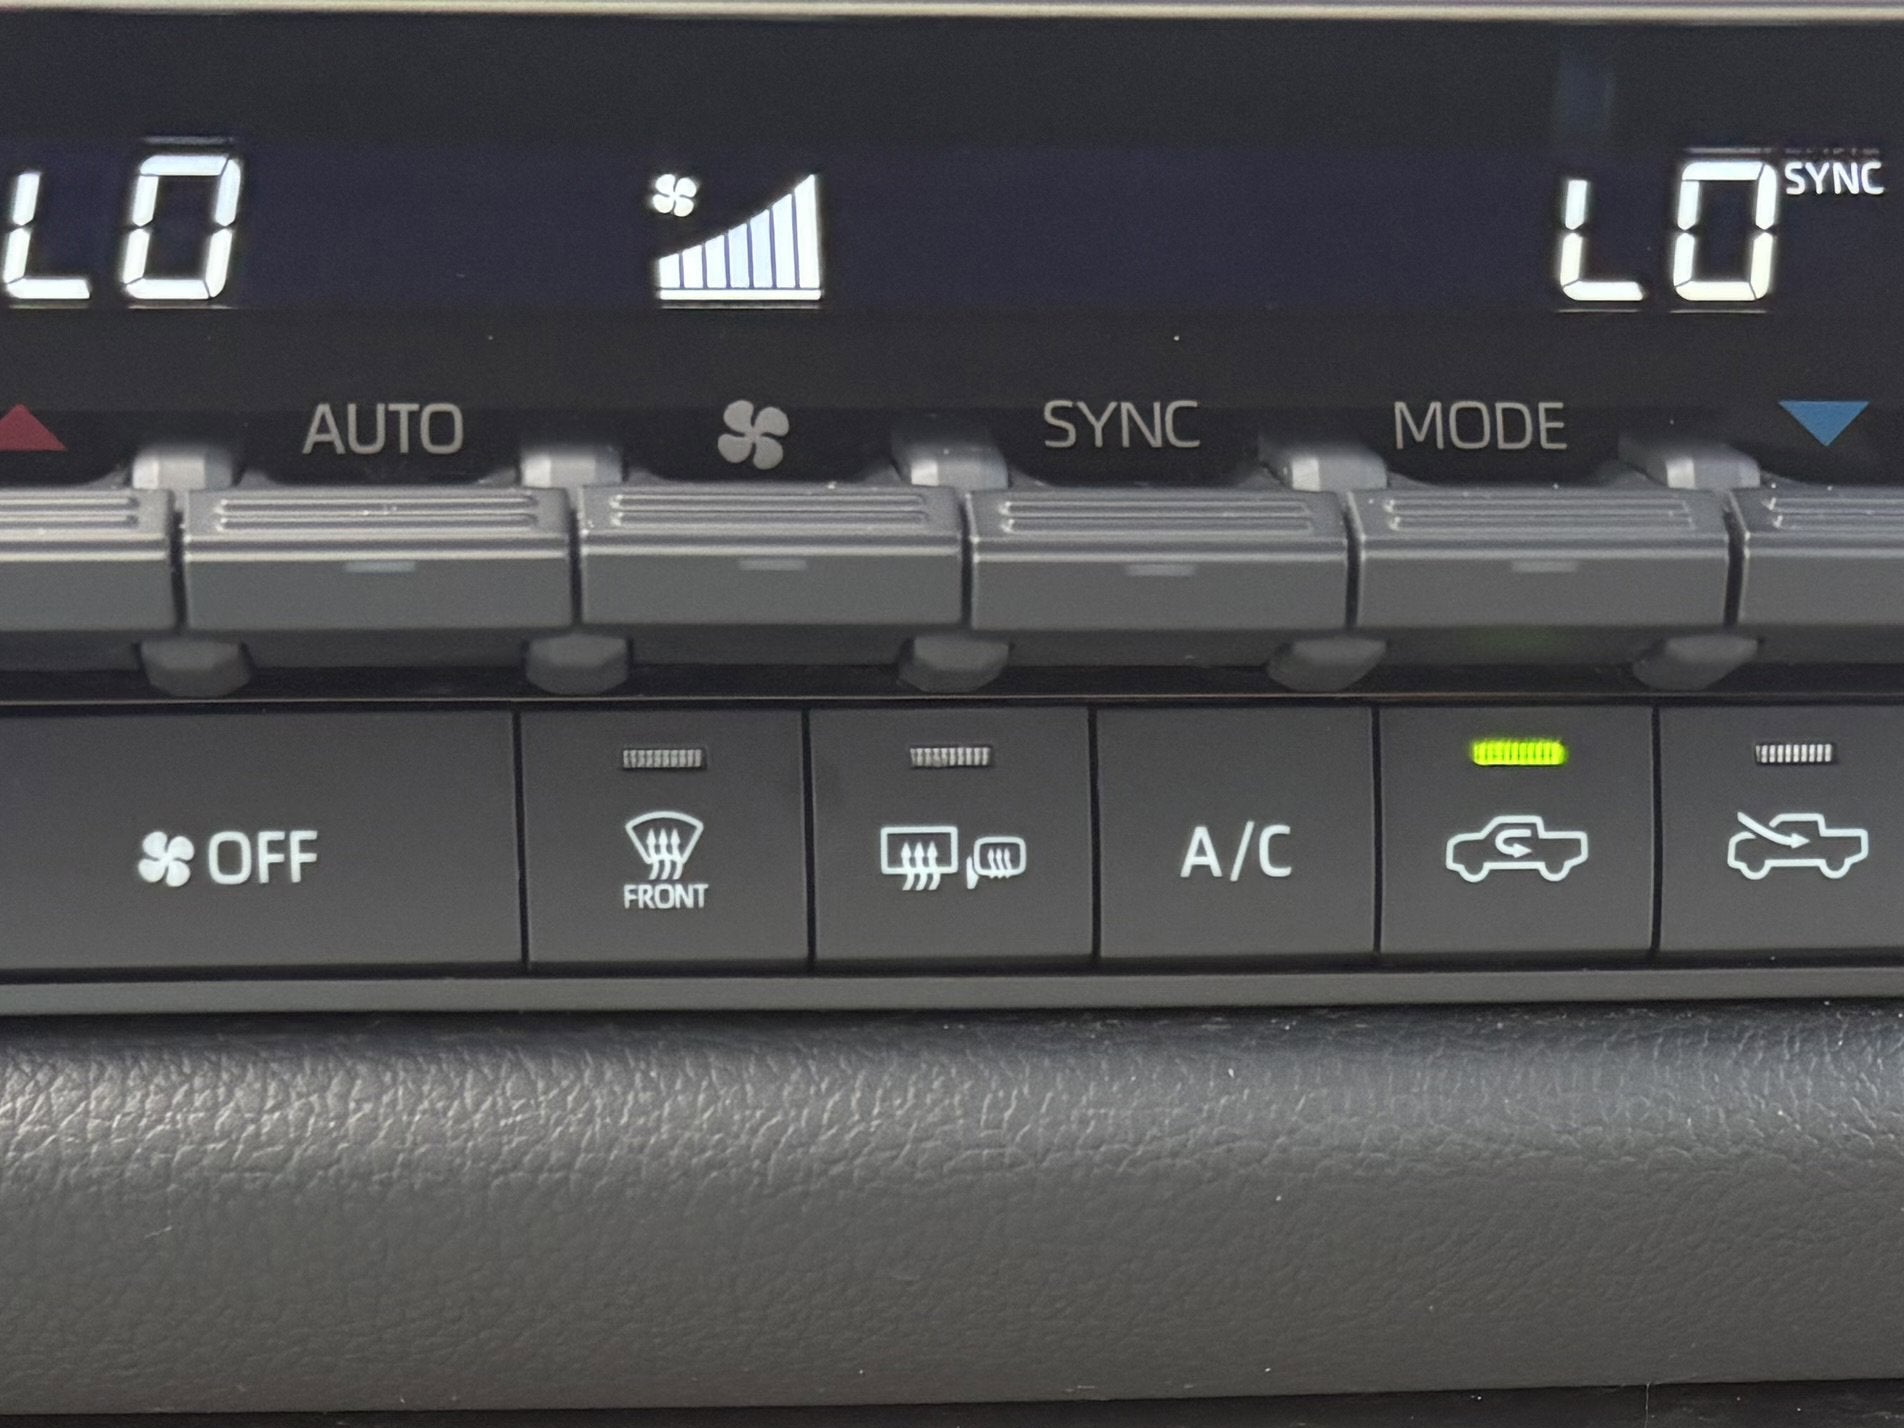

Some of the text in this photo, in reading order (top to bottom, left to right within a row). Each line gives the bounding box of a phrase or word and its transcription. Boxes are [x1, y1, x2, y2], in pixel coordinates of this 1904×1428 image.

[1783, 161, 1886, 195] SYNC
[302, 401, 465, 457] AUTO
[1043, 399, 1202, 449] SYNC
[1394, 400, 1569, 451] MODE
[206, 828, 319, 886] OFF
[1180, 820, 1294, 883] A/C
[622, 882, 709, 910] FRONT
